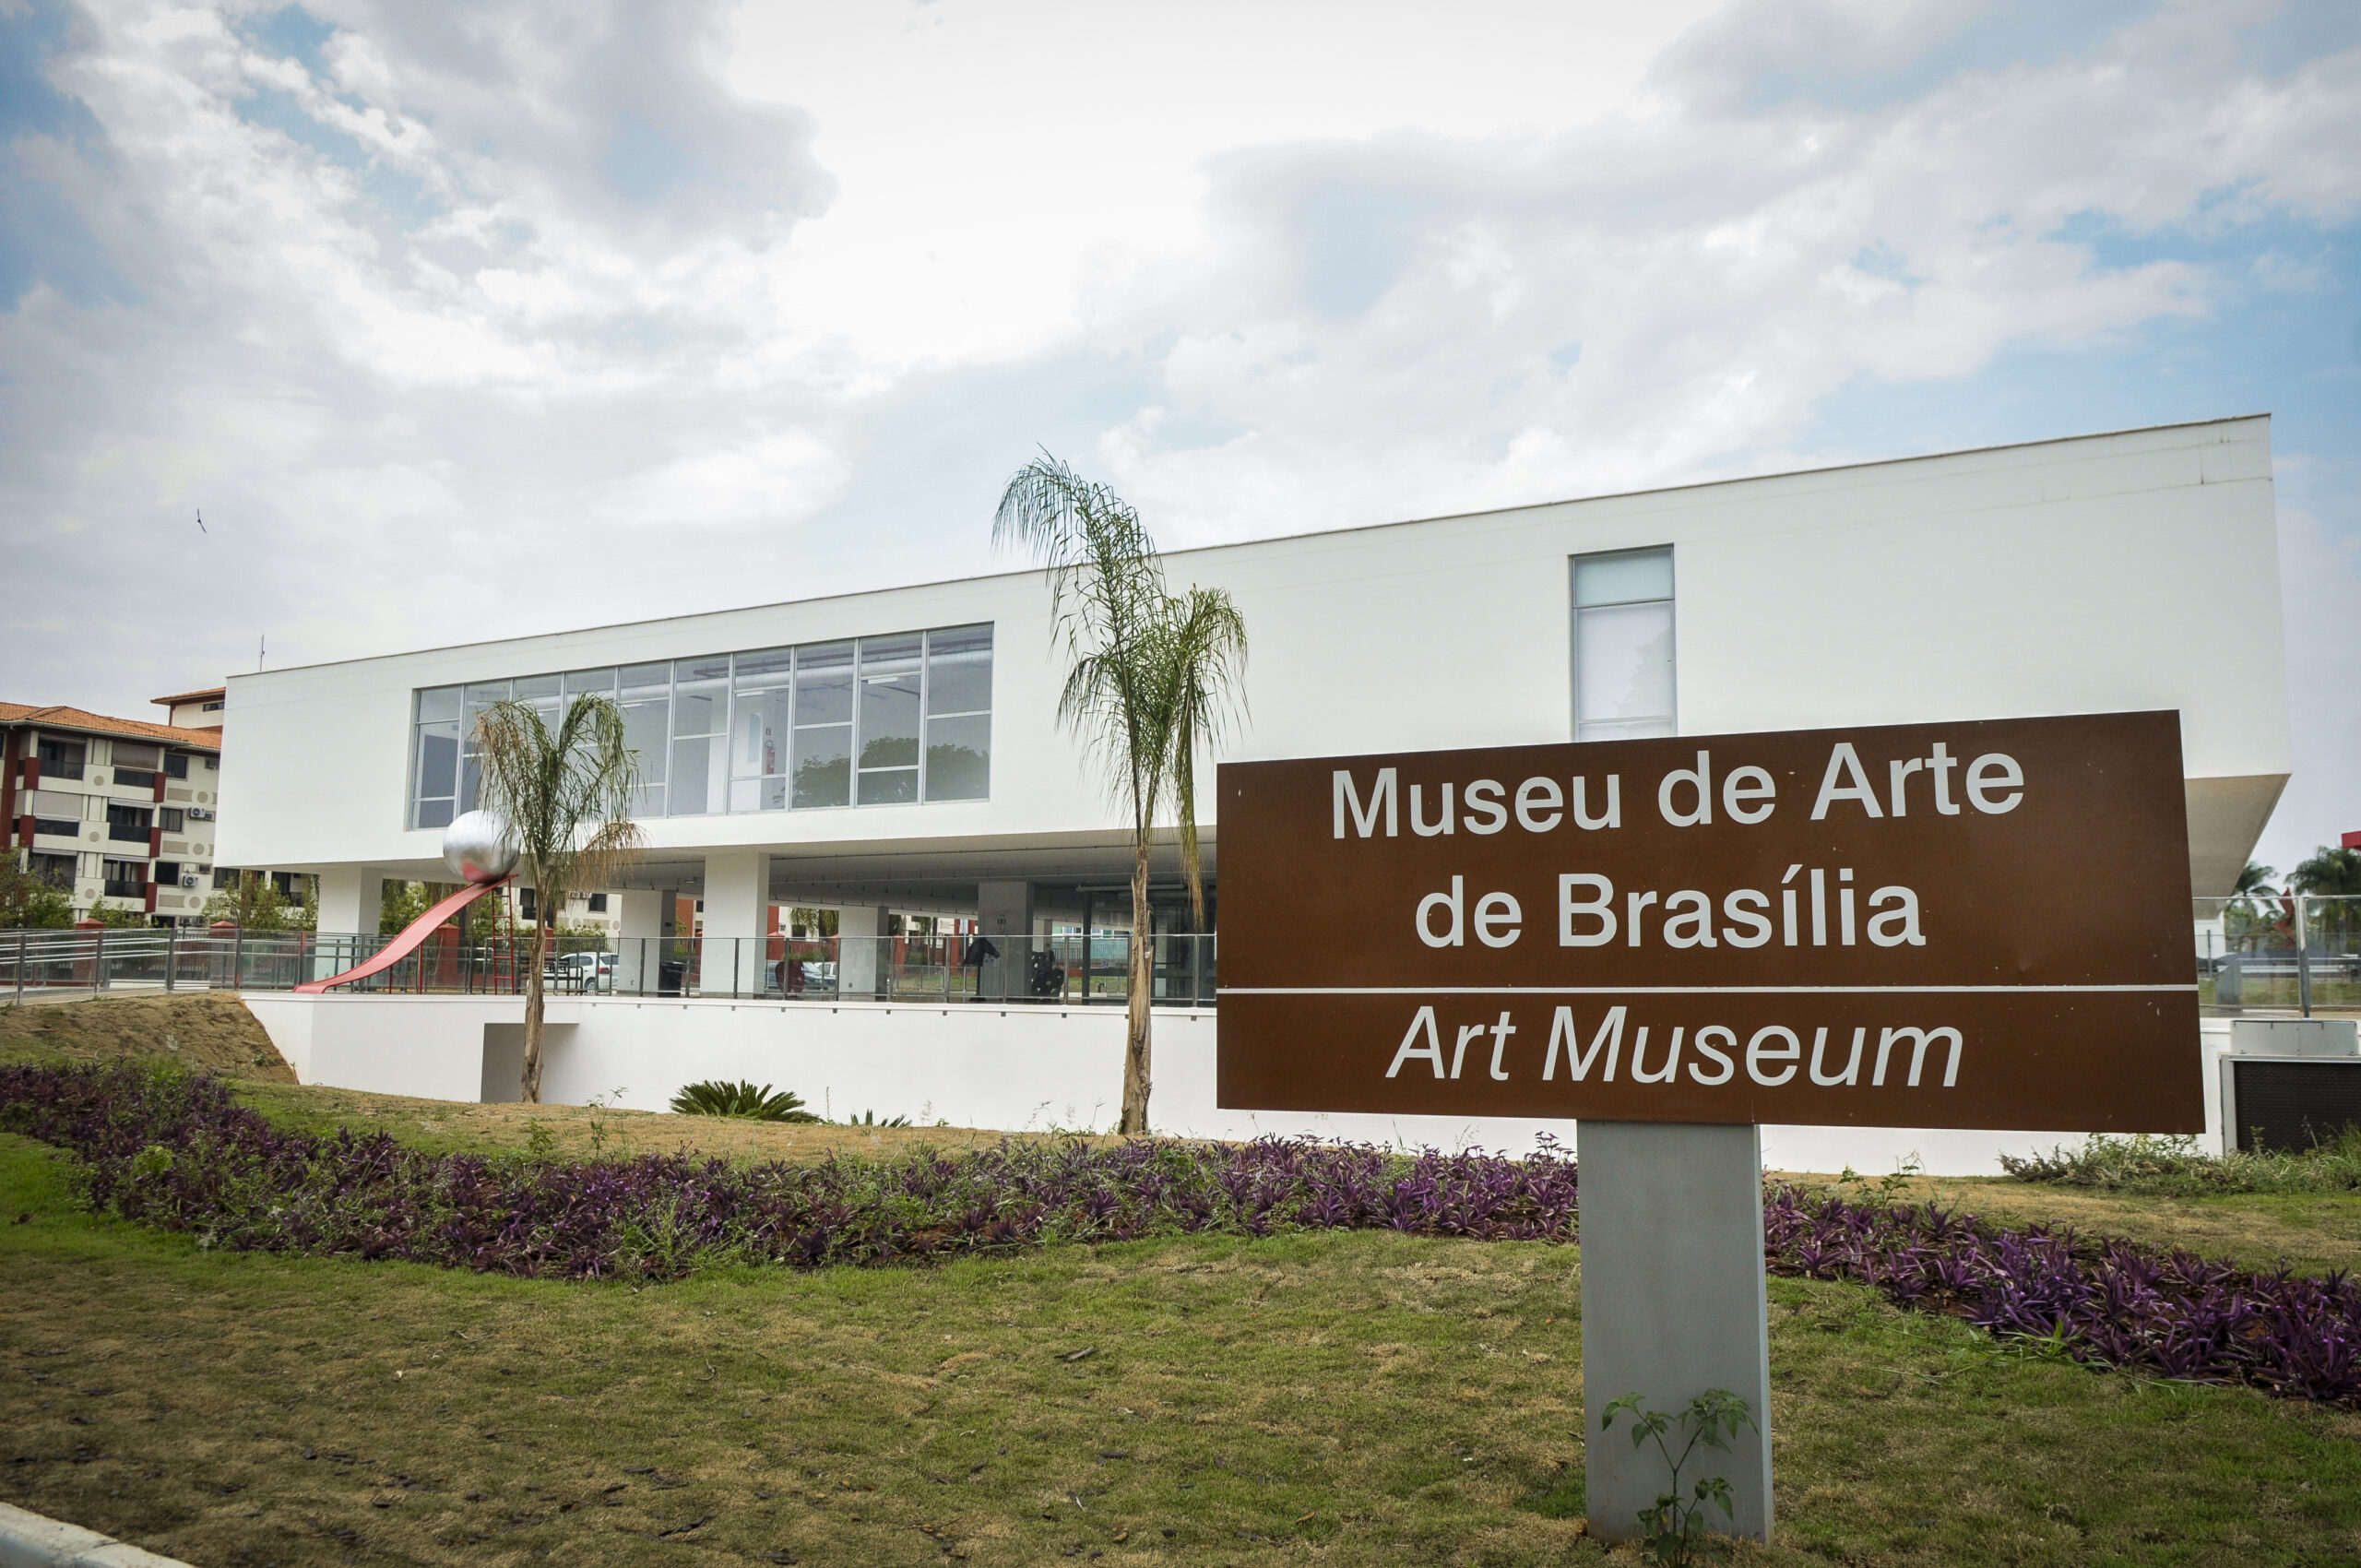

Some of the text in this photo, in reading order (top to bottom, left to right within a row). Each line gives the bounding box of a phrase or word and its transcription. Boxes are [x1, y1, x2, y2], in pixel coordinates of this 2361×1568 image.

[1333, 742, 2024, 839] Museu de Arte
[1416, 863, 1927, 949] de Brasília
[1385, 1005, 1963, 1087] Art Museum
